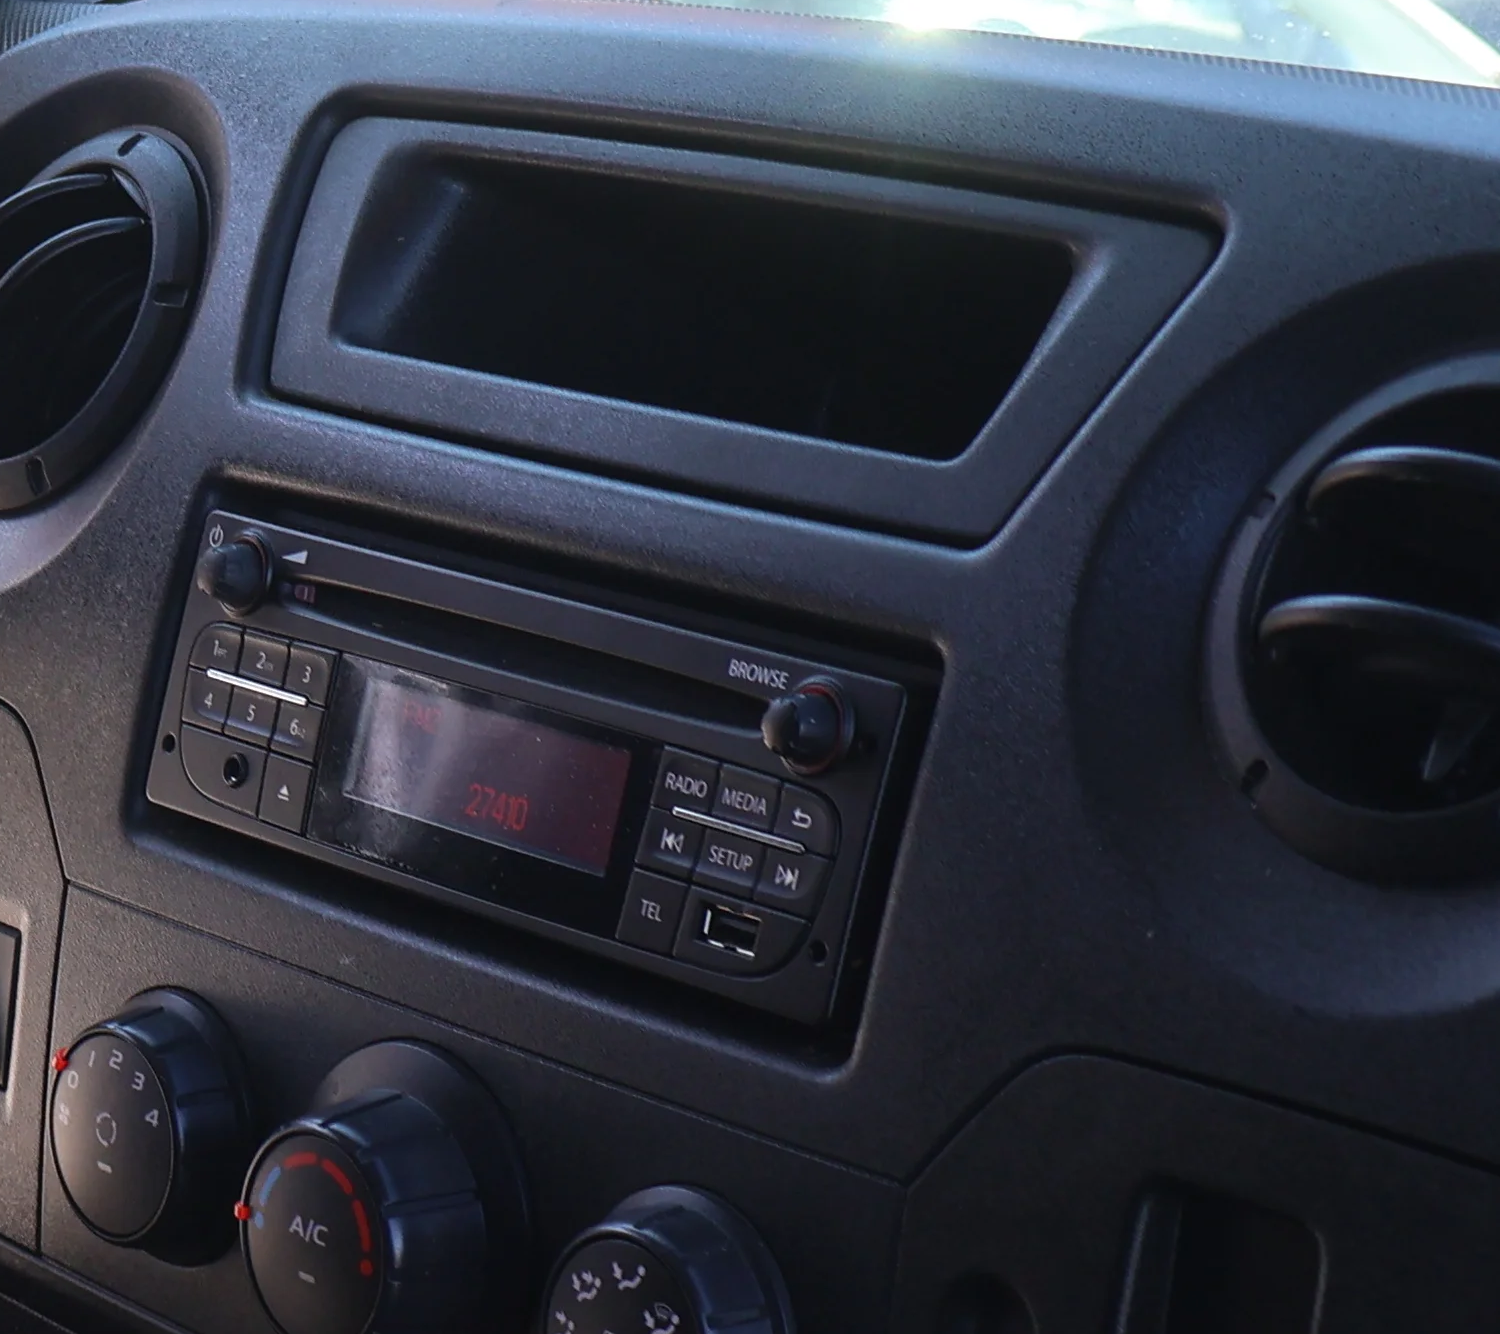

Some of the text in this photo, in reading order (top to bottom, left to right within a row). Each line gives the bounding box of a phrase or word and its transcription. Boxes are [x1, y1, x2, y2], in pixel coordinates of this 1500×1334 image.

[256, 651, 266, 670] 2
[302, 665, 311, 683] 3
[728, 658, 790, 690] BROWSE
[204, 692, 213, 709] 4
[246, 704, 257, 722] 5
[290, 718, 299, 736] 6
[664, 771, 708, 798] RADIO
[721, 786, 767, 816] MEDIA
[708, 844, 754, 872] SETUP
[640, 898, 662, 923] TEL
[88, 1050, 96, 1068] 1
[109, 1049, 123, 1071] 2
[68, 1071, 79, 1089] 0
[131, 1071, 145, 1091] 3
[144, 1109, 159, 1128] 4
[288, 1214, 329, 1247] A/C
